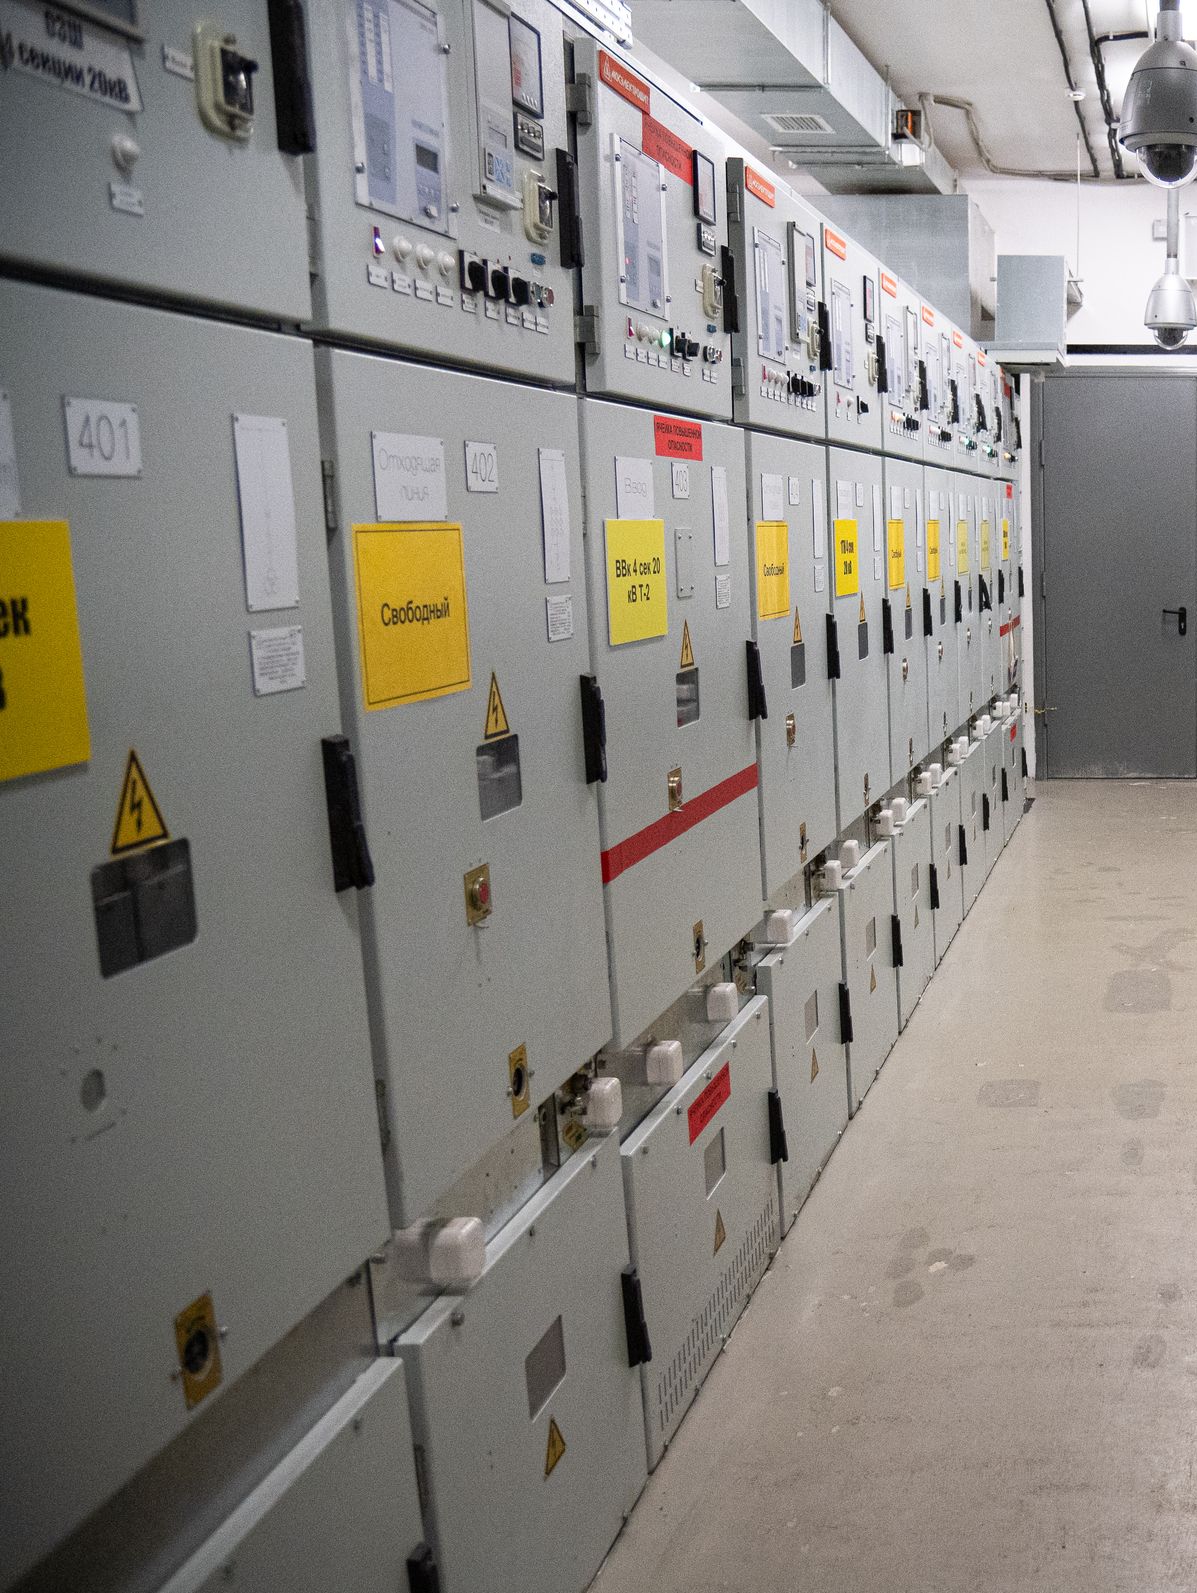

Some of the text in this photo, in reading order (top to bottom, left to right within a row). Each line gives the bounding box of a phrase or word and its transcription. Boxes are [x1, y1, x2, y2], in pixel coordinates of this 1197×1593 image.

[87, 64, 131, 104] 20кВ
[79, 412, 130, 460] 401
[471, 452, 495, 482] 402
[675, 470, 688, 492] 403
[615, 557, 661, 578] ВВк 4 сек 20
[627, 583, 650, 603] кВ Т-2
[380, 596, 451, 627] Свободный
